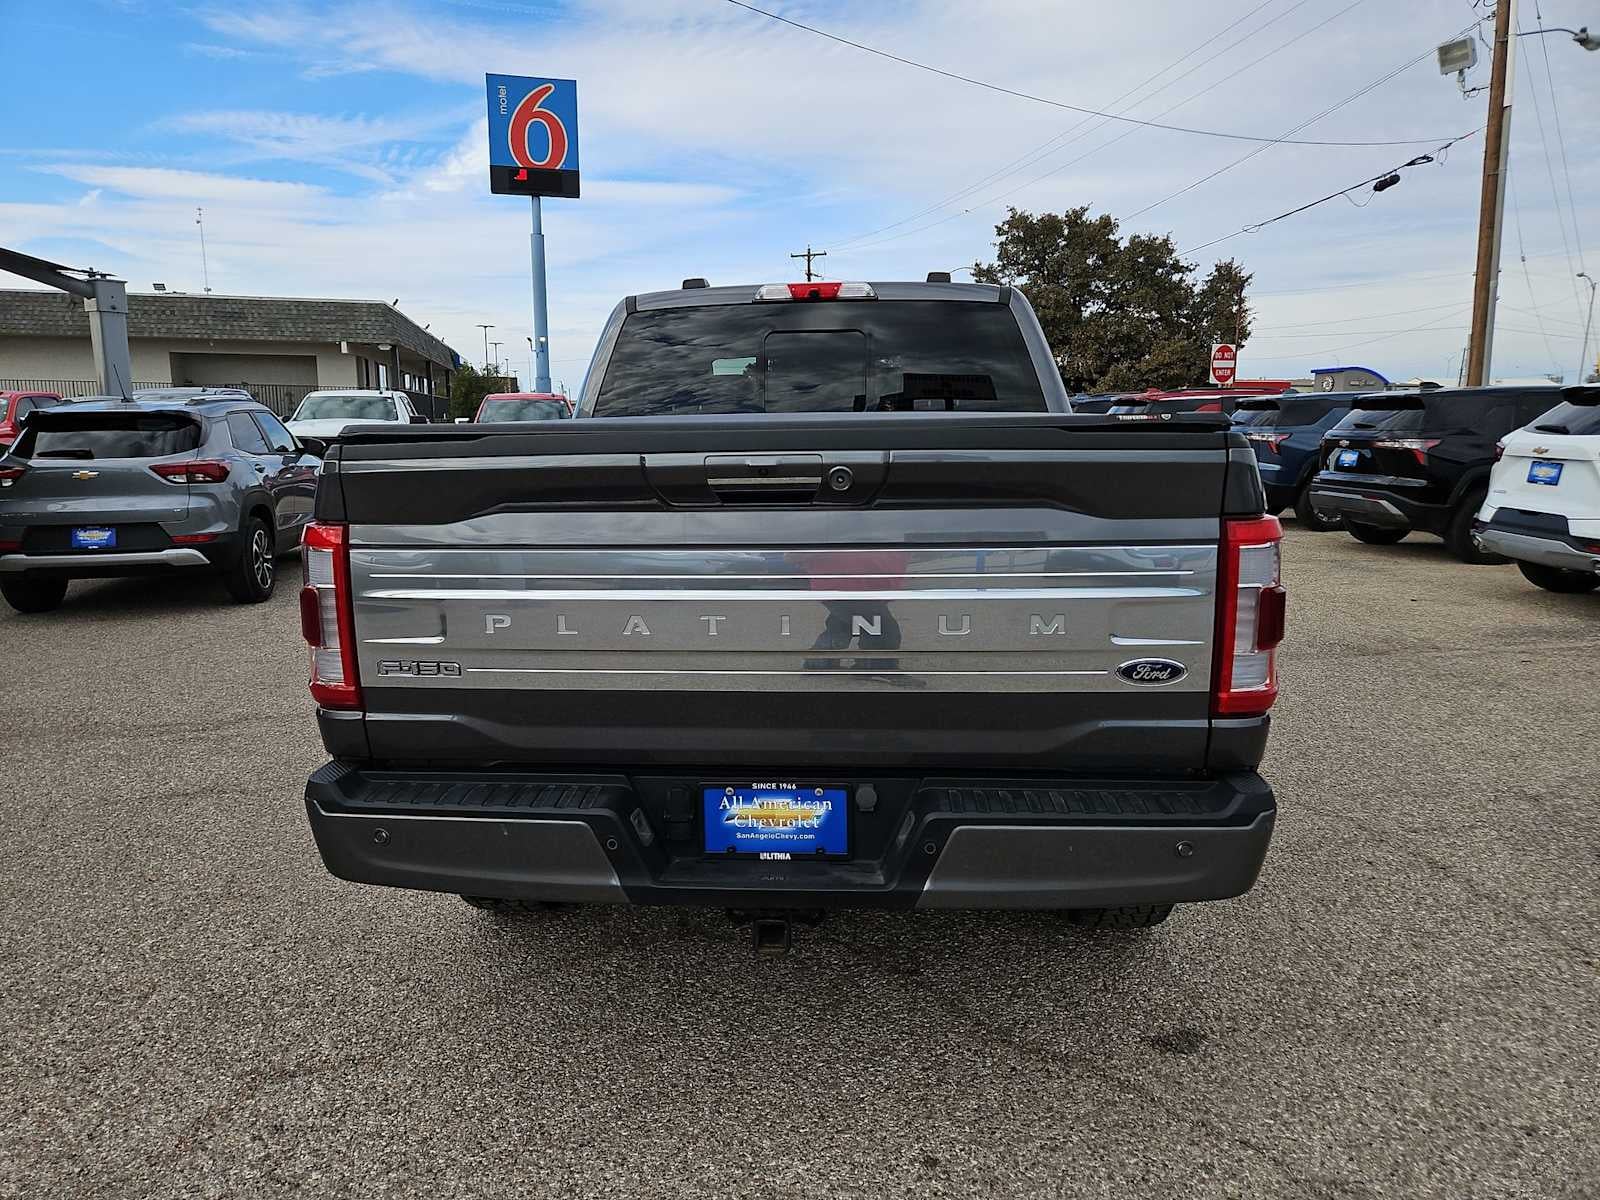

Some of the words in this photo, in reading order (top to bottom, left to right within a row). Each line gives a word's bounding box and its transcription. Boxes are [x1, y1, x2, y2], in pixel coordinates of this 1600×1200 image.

[498, 85, 507, 115] motel
[508, 83, 568, 169] 6
[484, 614, 1066, 636] PLATINUM
[1133, 664, 1171, 680] Ford
[720, 796, 743, 810] All
[751, 796, 832, 811] American
[735, 814, 820, 828] Chevrolet
[736, 832, 815, 840] SanAngeloChevy.com
